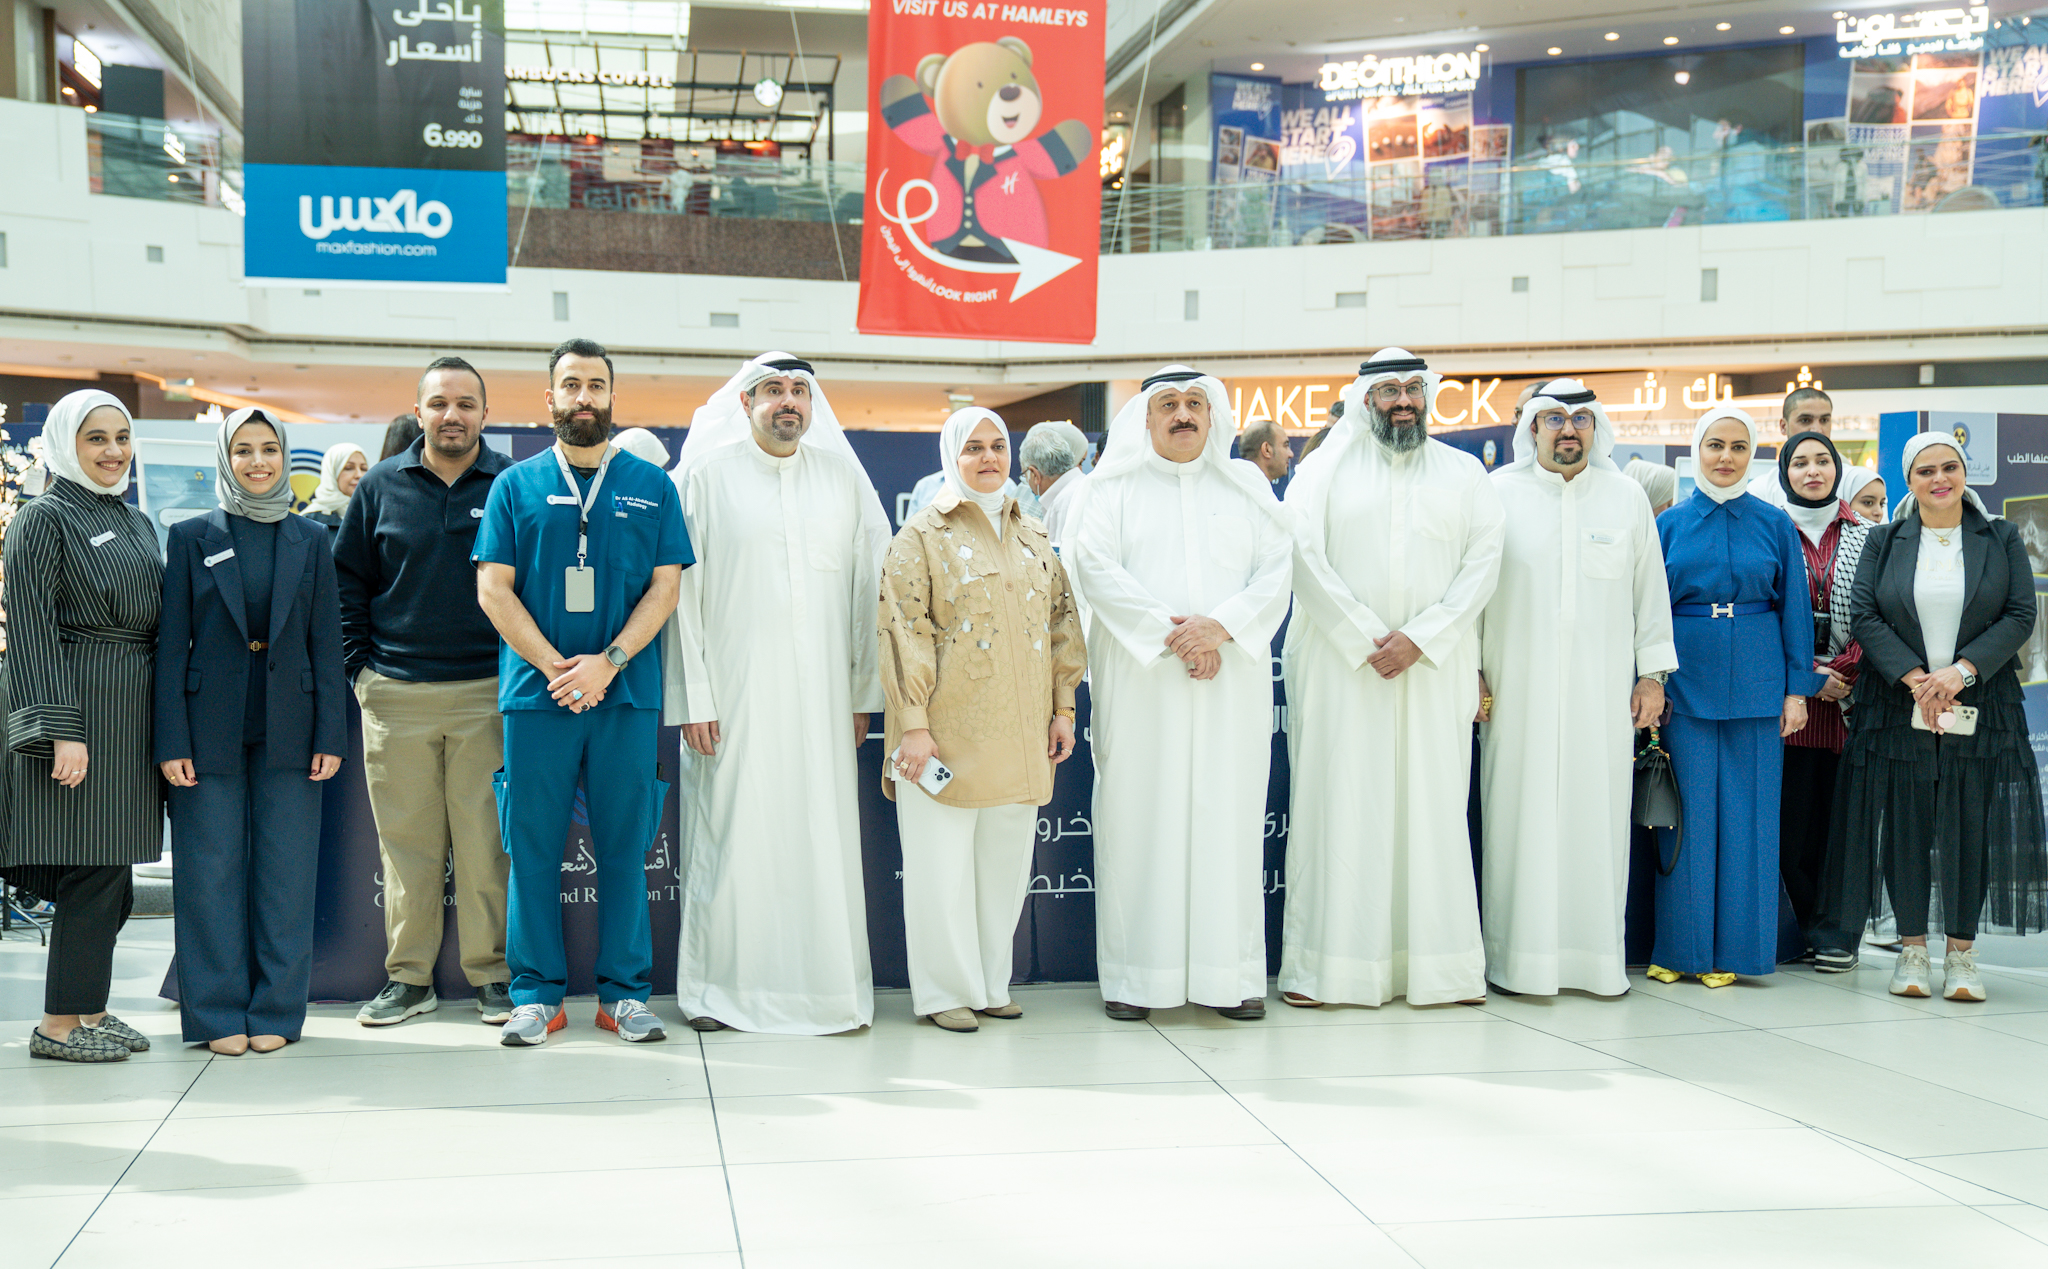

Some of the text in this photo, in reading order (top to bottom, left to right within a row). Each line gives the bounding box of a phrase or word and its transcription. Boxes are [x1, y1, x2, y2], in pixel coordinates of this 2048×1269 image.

[892, 0, 1089, 27] VISIT US AT HAMLEYS
[386, 31, 483, 66] أسعار
[597, 69, 673, 88] COFFEE
[1319, 51, 1480, 91] DECATHLON
[1984, 60, 2048, 80] STAR
[423, 122, 483, 149] 6.990
[316, 240, 438, 257] maxfashion.com
[929, 282, 998, 303] LOOK RIGHT
